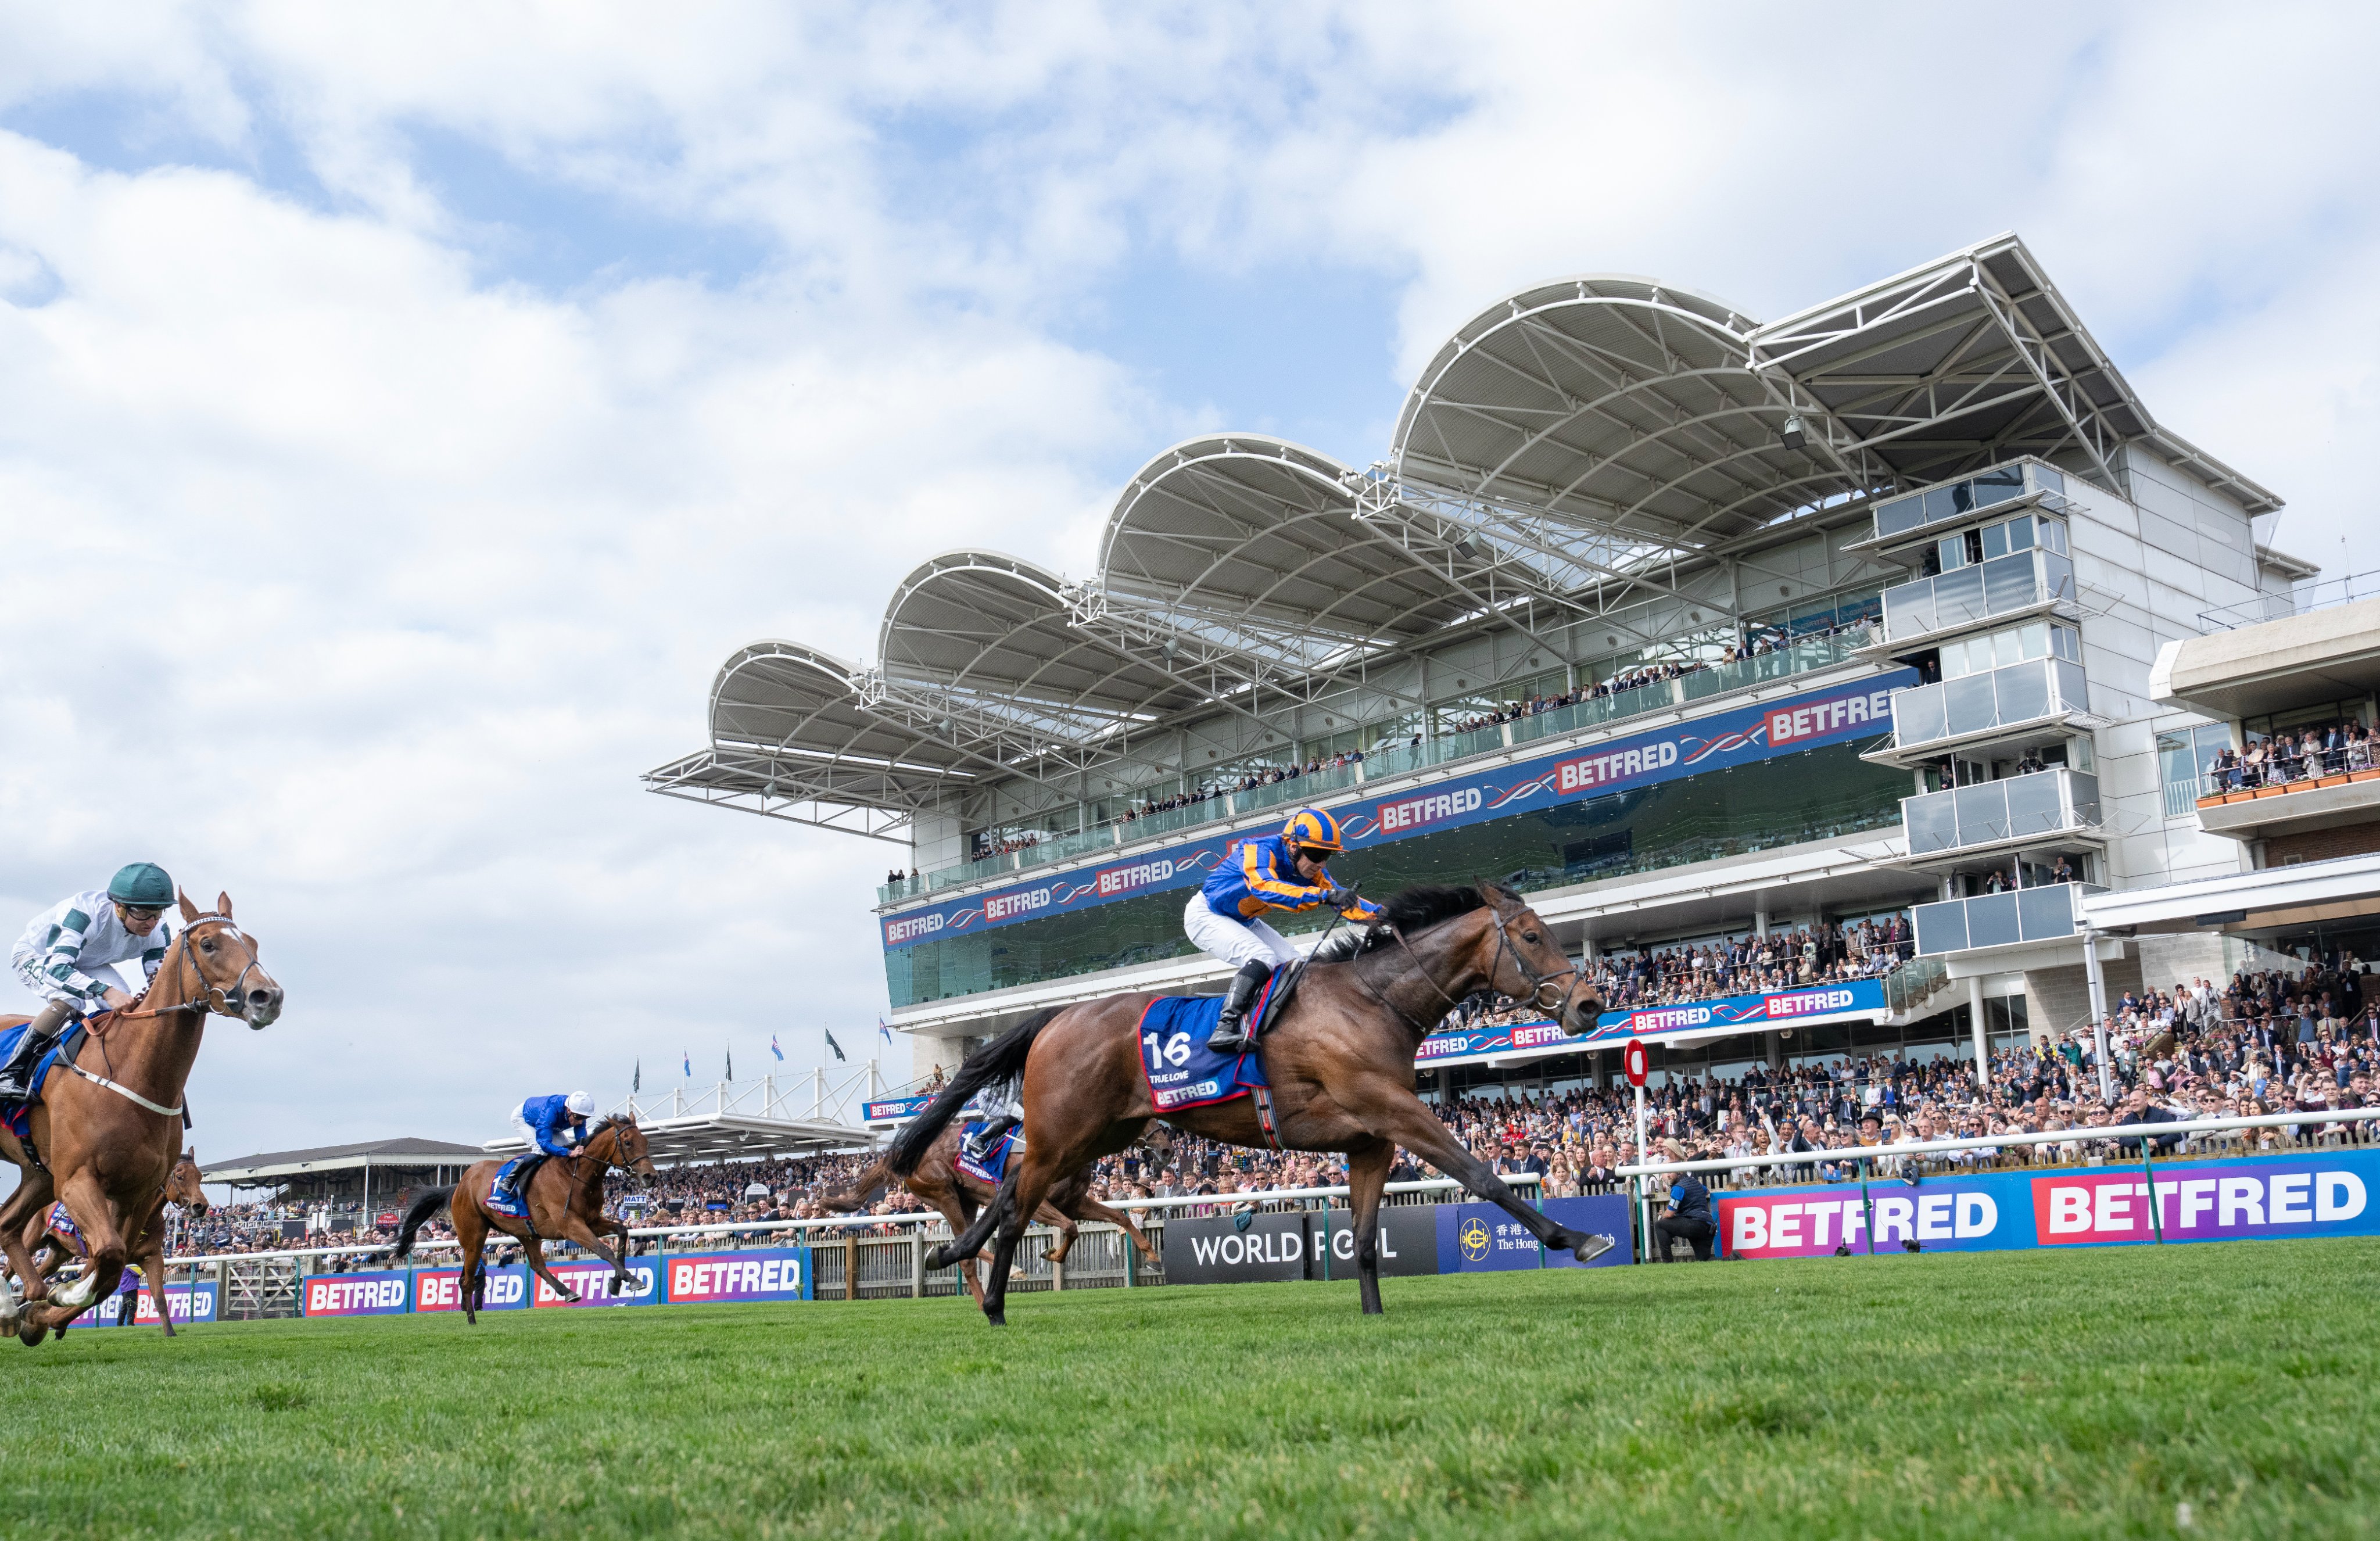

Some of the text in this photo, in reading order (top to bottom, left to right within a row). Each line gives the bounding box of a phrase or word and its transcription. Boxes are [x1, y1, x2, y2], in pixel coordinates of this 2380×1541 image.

[1773, 686, 1909, 741] BETFRE
[1561, 740, 1678, 790] BETFRED
[1383, 787, 1481, 830] BETFRED
[1101, 860, 1173, 894] BETFRED
[987, 888, 1050, 919] BETFRED
[888, 913, 944, 941] BETFRED
[1769, 990, 1854, 1015] BETFRED
[1635, 1008, 1711, 1030] BETFRED
[1416, 1037, 1468, 1056] ETFRED
[1514, 1025, 1583, 1045] BETFR
[1144, 1032, 1191, 1069] 16
[1149, 1070, 1189, 1084] TRUE LOVE
[1157, 1081, 1218, 1105] BETFRED
[872, 1102, 906, 1116] BETFRED
[959, 1159, 992, 1179] BETFRED
[486, 1202, 516, 1212] BETFRED
[2049, 1171, 2367, 1234] BETFRED
[1732, 1192, 1998, 1250] BETFRED
[1191, 1228, 1397, 1266] WORLD POL
[1497, 1239, 1514, 1250] The
[1516, 1238, 1539, 1251] Hong
[421, 1275, 523, 1306] BETRED
[673, 1259, 800, 1295] BETFRED
[310, 1280, 405, 1310] BETFRED
